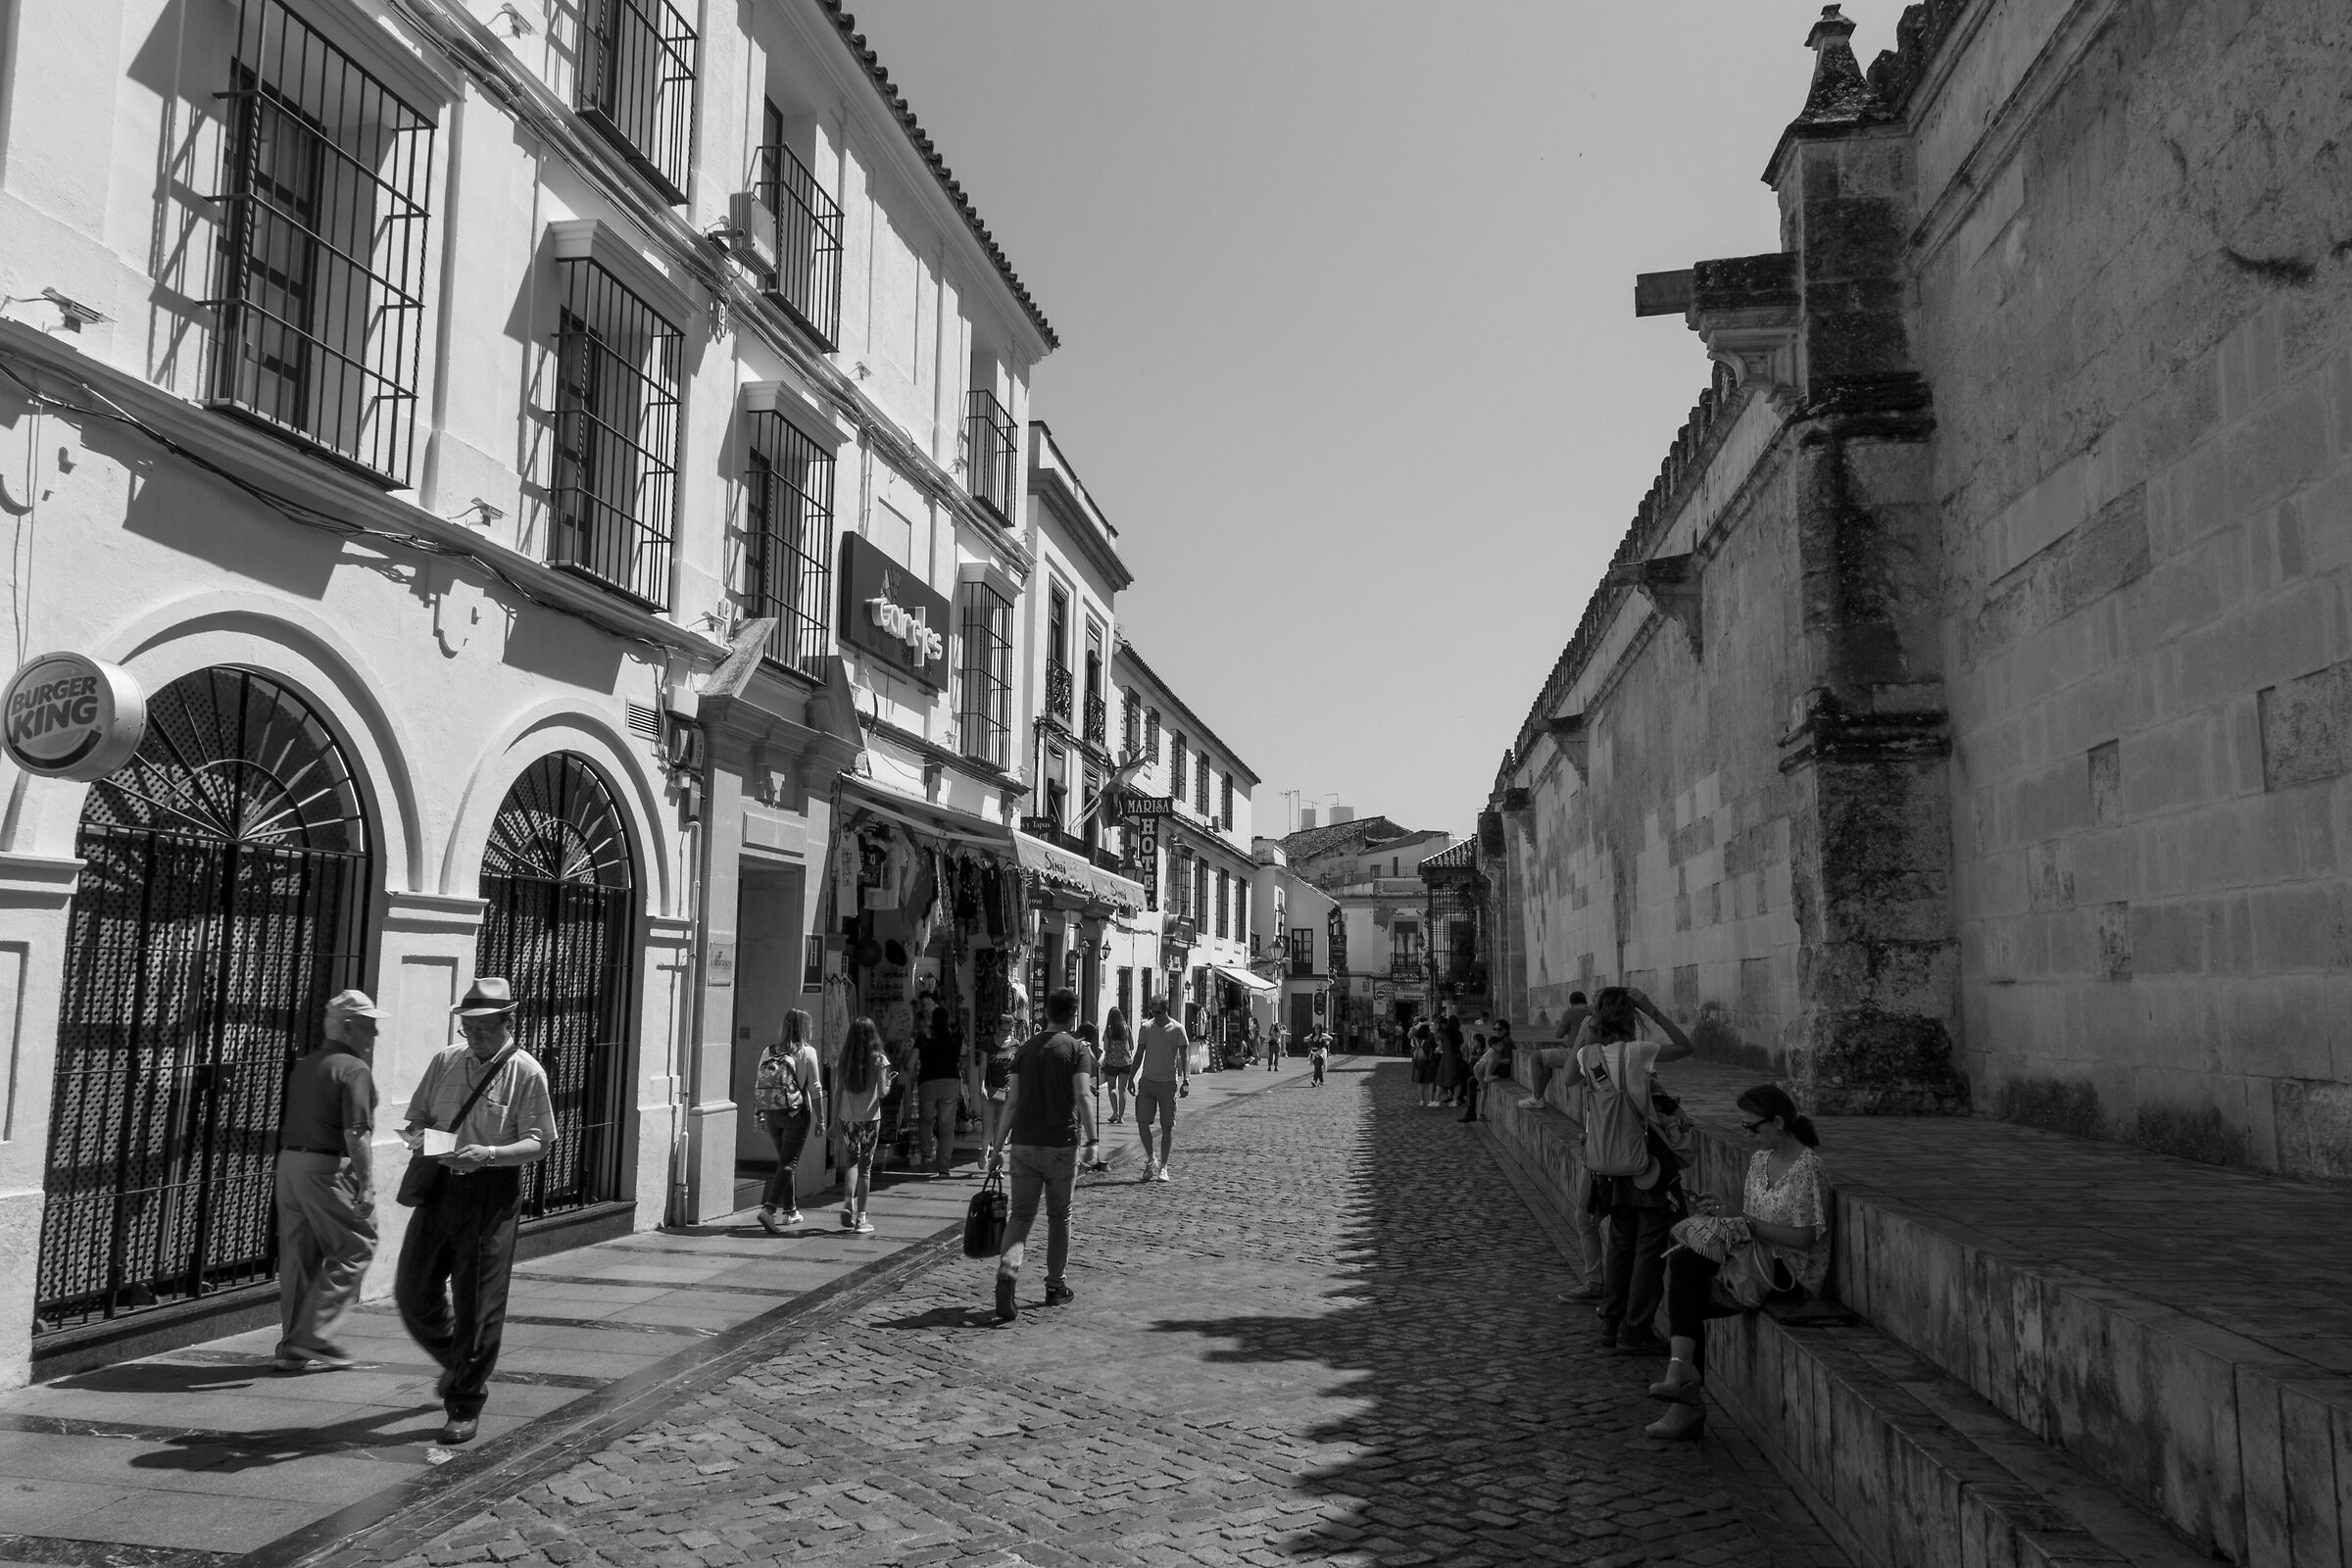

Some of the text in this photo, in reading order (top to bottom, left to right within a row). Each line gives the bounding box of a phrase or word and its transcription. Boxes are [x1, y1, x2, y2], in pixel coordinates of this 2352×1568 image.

[11, 676, 97, 716] BURGER
[12, 696, 98, 745] KING
[1127, 799, 1169, 813] MARISA
[1031, 820, 1051, 830] Tapas
[808, 939, 818, 966] H
